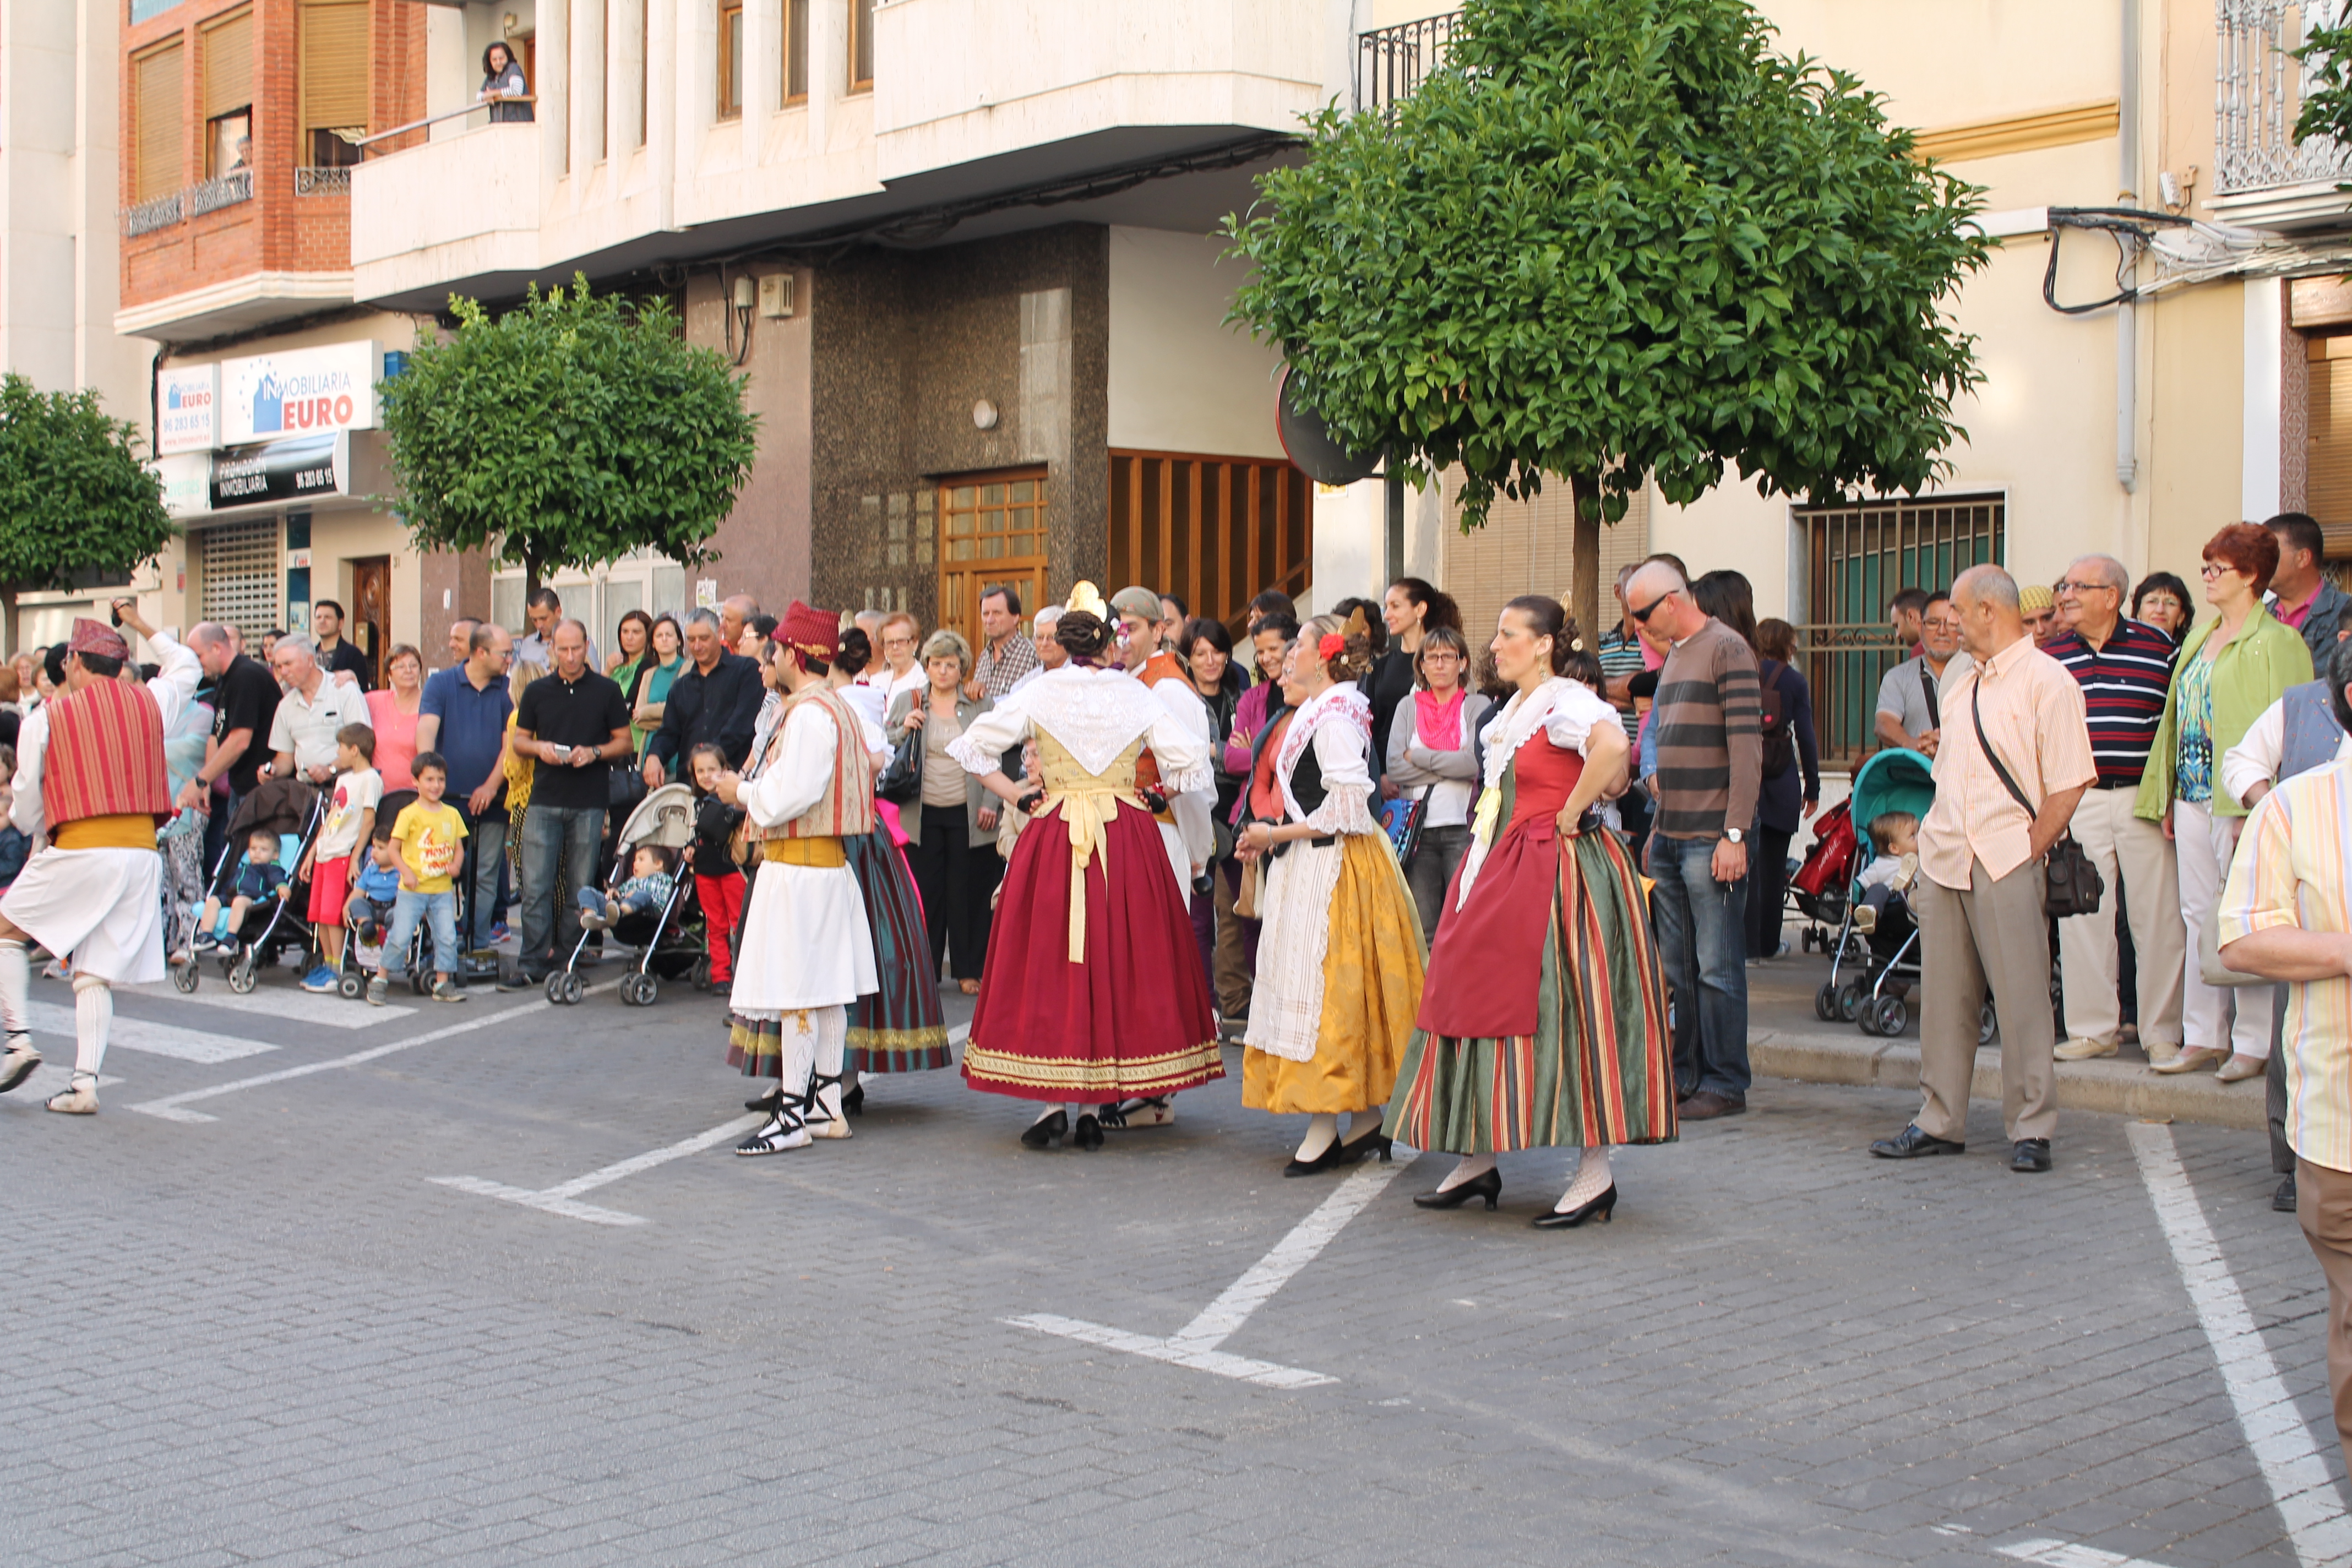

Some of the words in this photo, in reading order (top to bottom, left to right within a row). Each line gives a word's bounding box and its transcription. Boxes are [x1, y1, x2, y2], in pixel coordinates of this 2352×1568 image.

[263, 371, 351, 401] INMOBILIARIA
[182, 391, 211, 409] EURO
[164, 418, 173, 433] 96
[175, 415, 188, 432] 283
[190, 413, 199, 429] 65
[202, 412, 210, 427] 15
[284, 394, 353, 431] EURO
[220, 474, 268, 498] INMOBILIARIA
[296, 471, 304, 489] 96
[324, 467, 333, 485] 15
